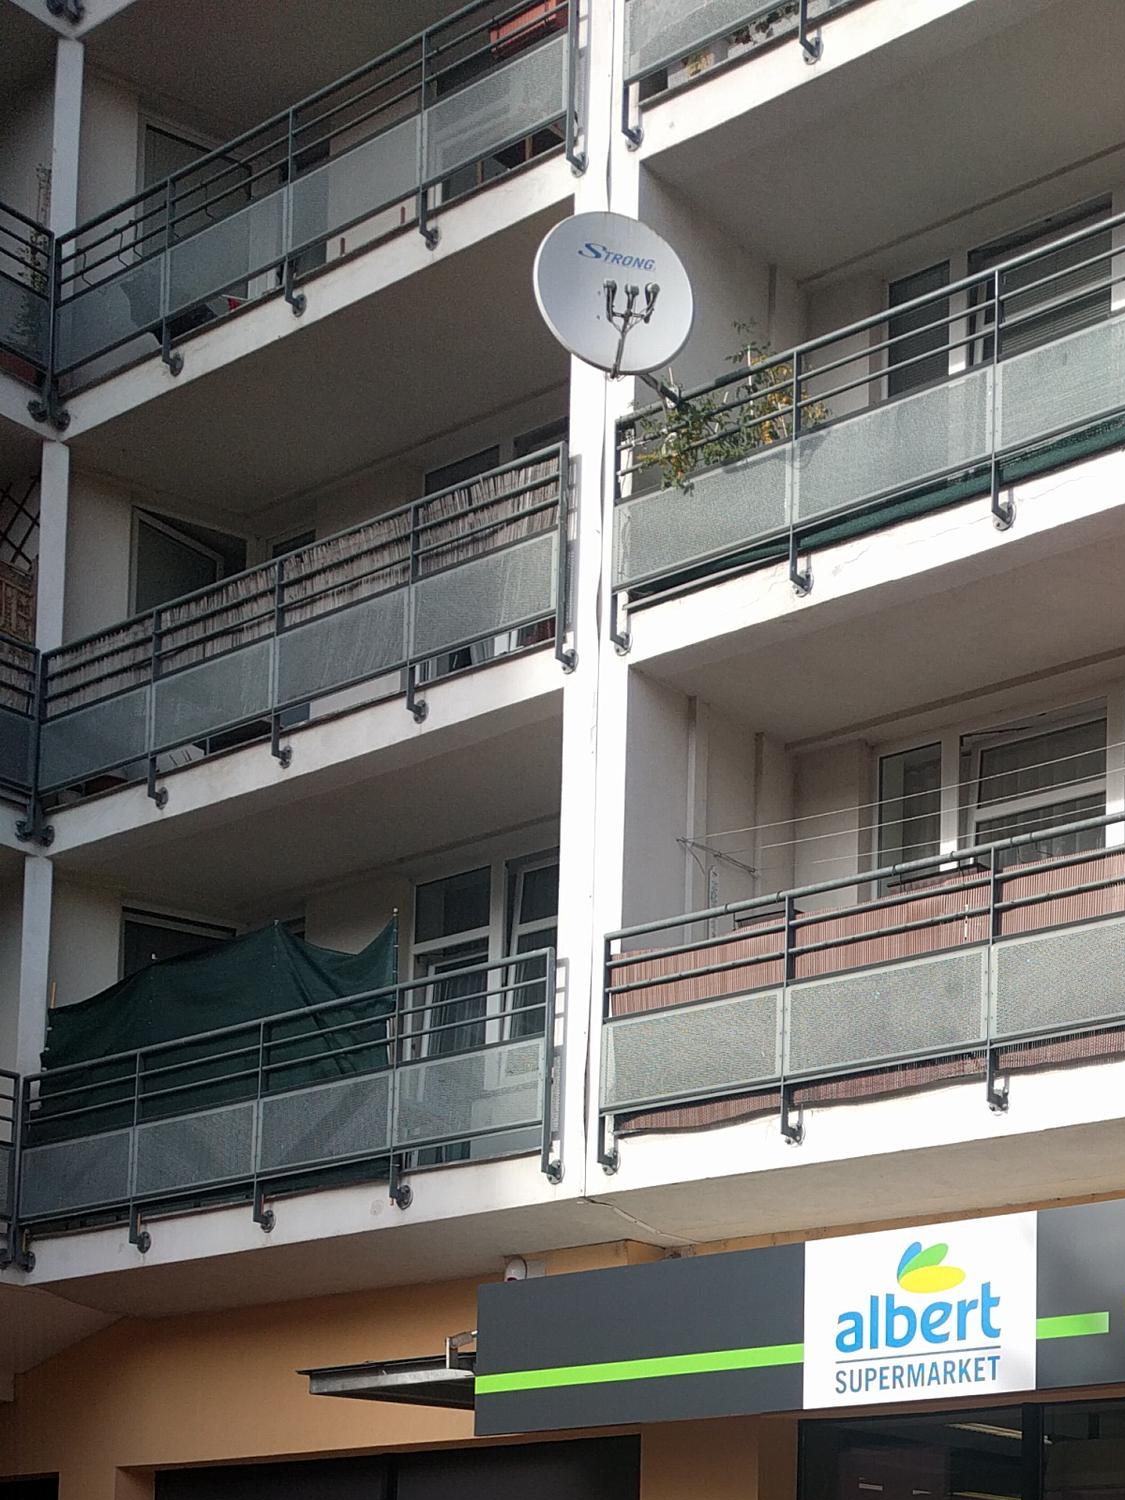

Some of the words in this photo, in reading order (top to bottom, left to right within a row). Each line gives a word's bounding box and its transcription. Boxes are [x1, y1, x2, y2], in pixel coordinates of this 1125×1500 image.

[578, 243, 655, 271] STRONG
[835, 1281, 1001, 1353] albert
[835, 1355, 1001, 1394] SUPERMARKET
